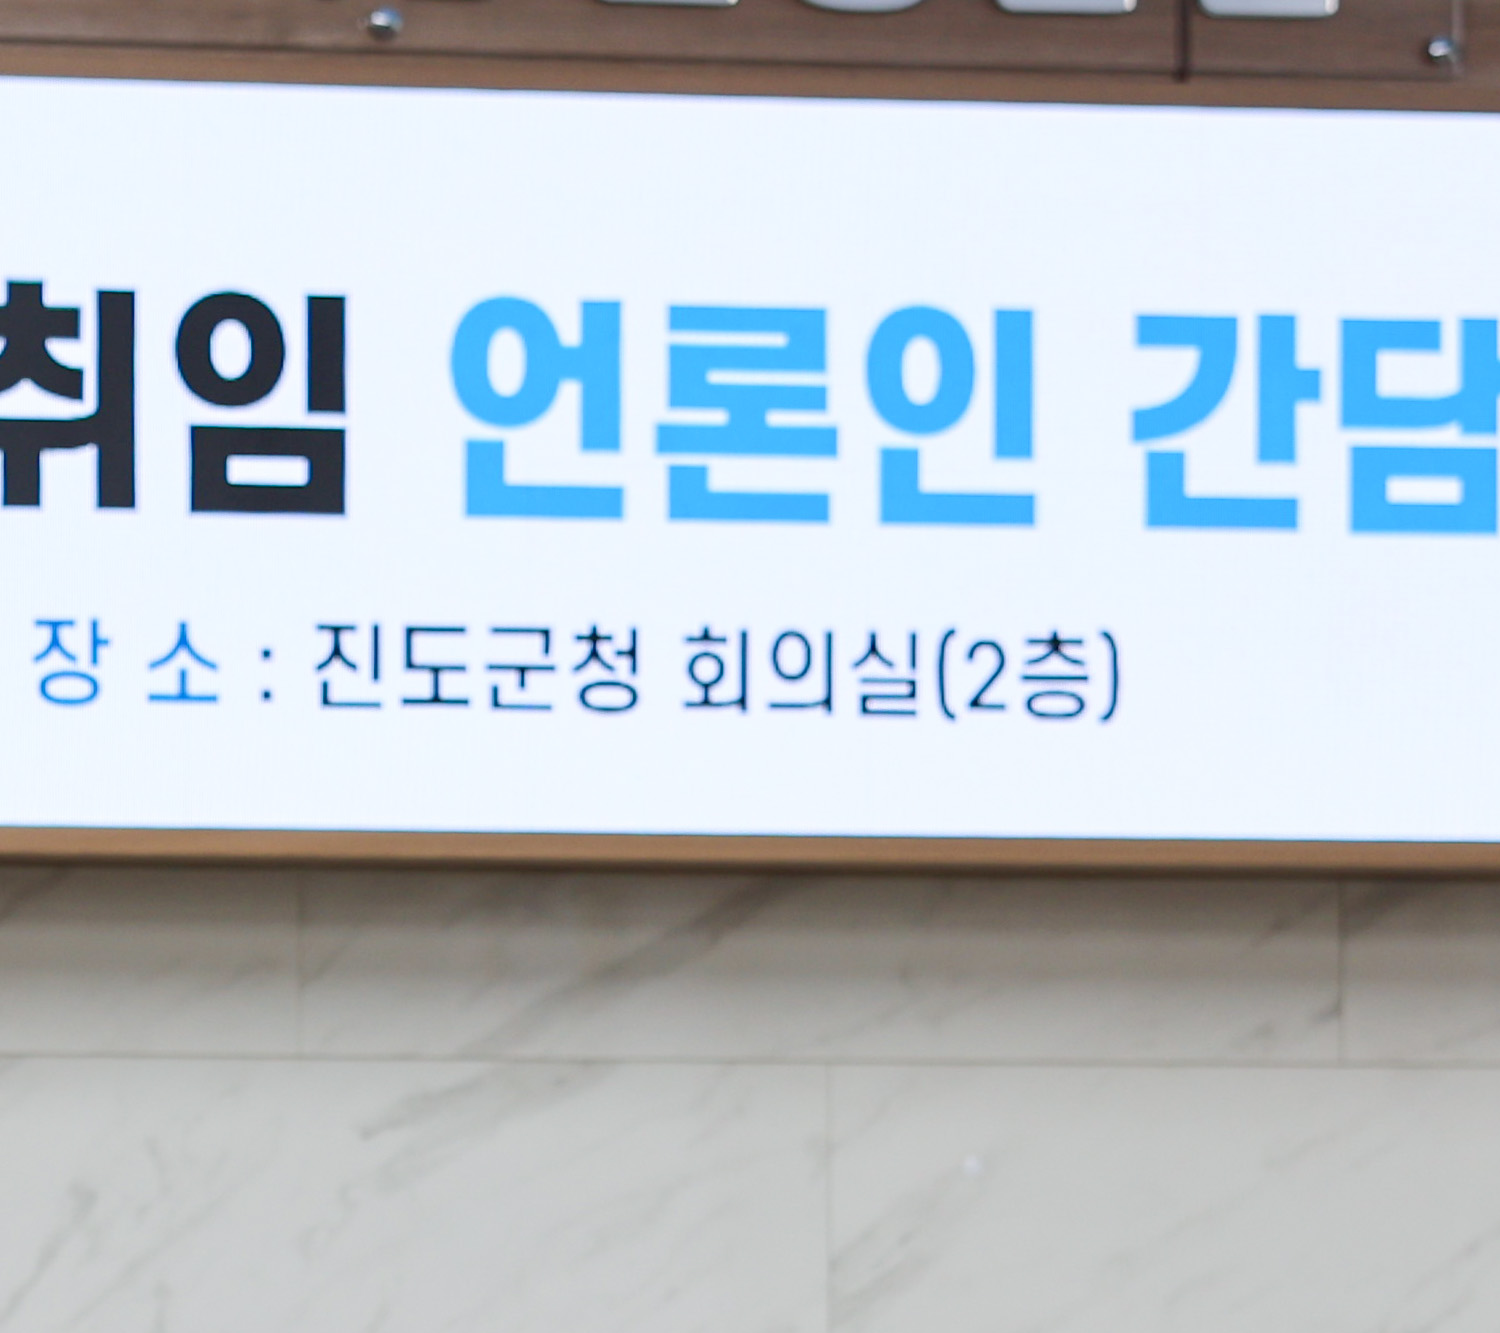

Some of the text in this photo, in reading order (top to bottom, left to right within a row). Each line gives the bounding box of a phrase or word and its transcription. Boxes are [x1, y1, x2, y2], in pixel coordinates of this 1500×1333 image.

[449, 295, 1037, 527] 언론인
[315, 623, 639, 714] 진도군청
[684, 625, 1119, 722] 회의실(2층)
